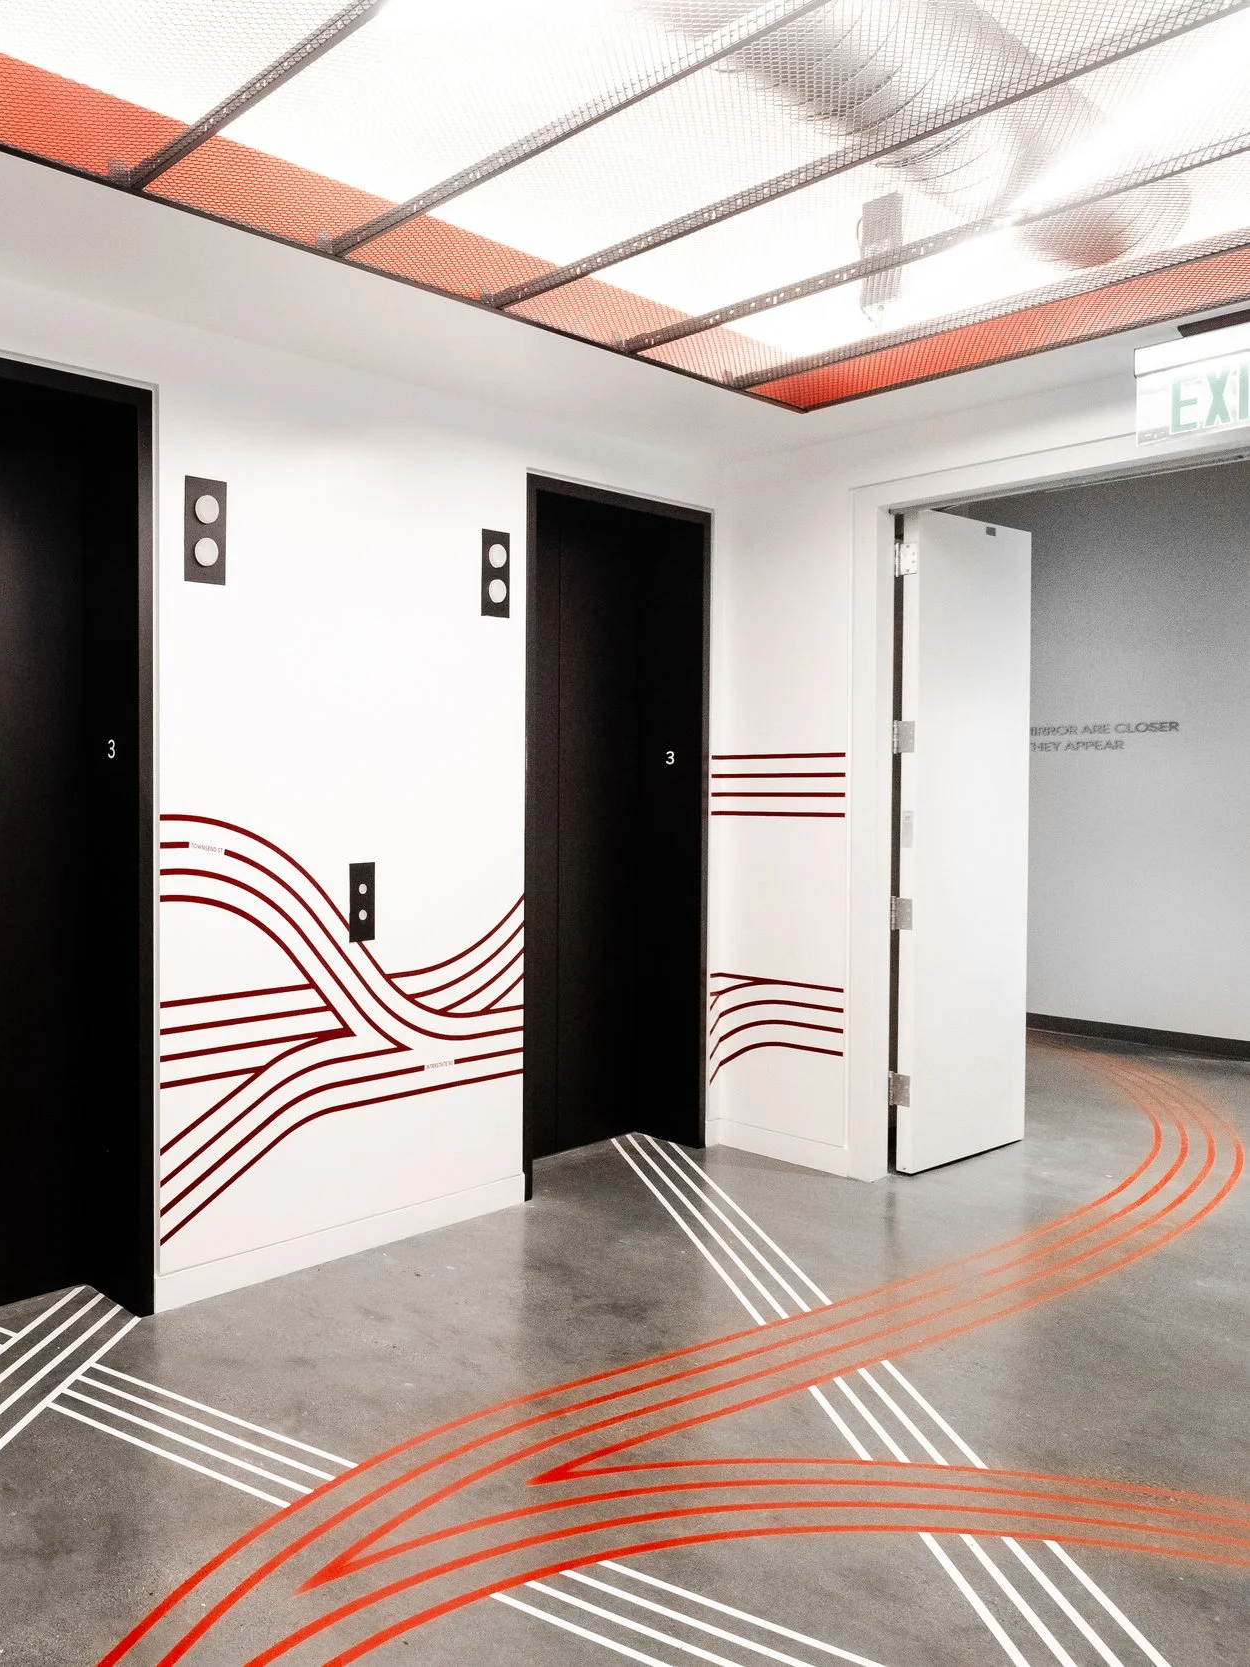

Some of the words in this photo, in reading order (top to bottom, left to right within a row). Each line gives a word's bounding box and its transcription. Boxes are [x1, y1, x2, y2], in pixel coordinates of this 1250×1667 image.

[1171, 364, 1250, 433] EXI
[1083, 724, 1110, 734] ARE
[1114, 721, 1179, 734] CLOSER
[107, 739, 116, 759] 3
[1064, 740, 1124, 751] APPEAR
[665, 750, 675, 765] 3
[191, 843, 217, 852] TOWNSEND
